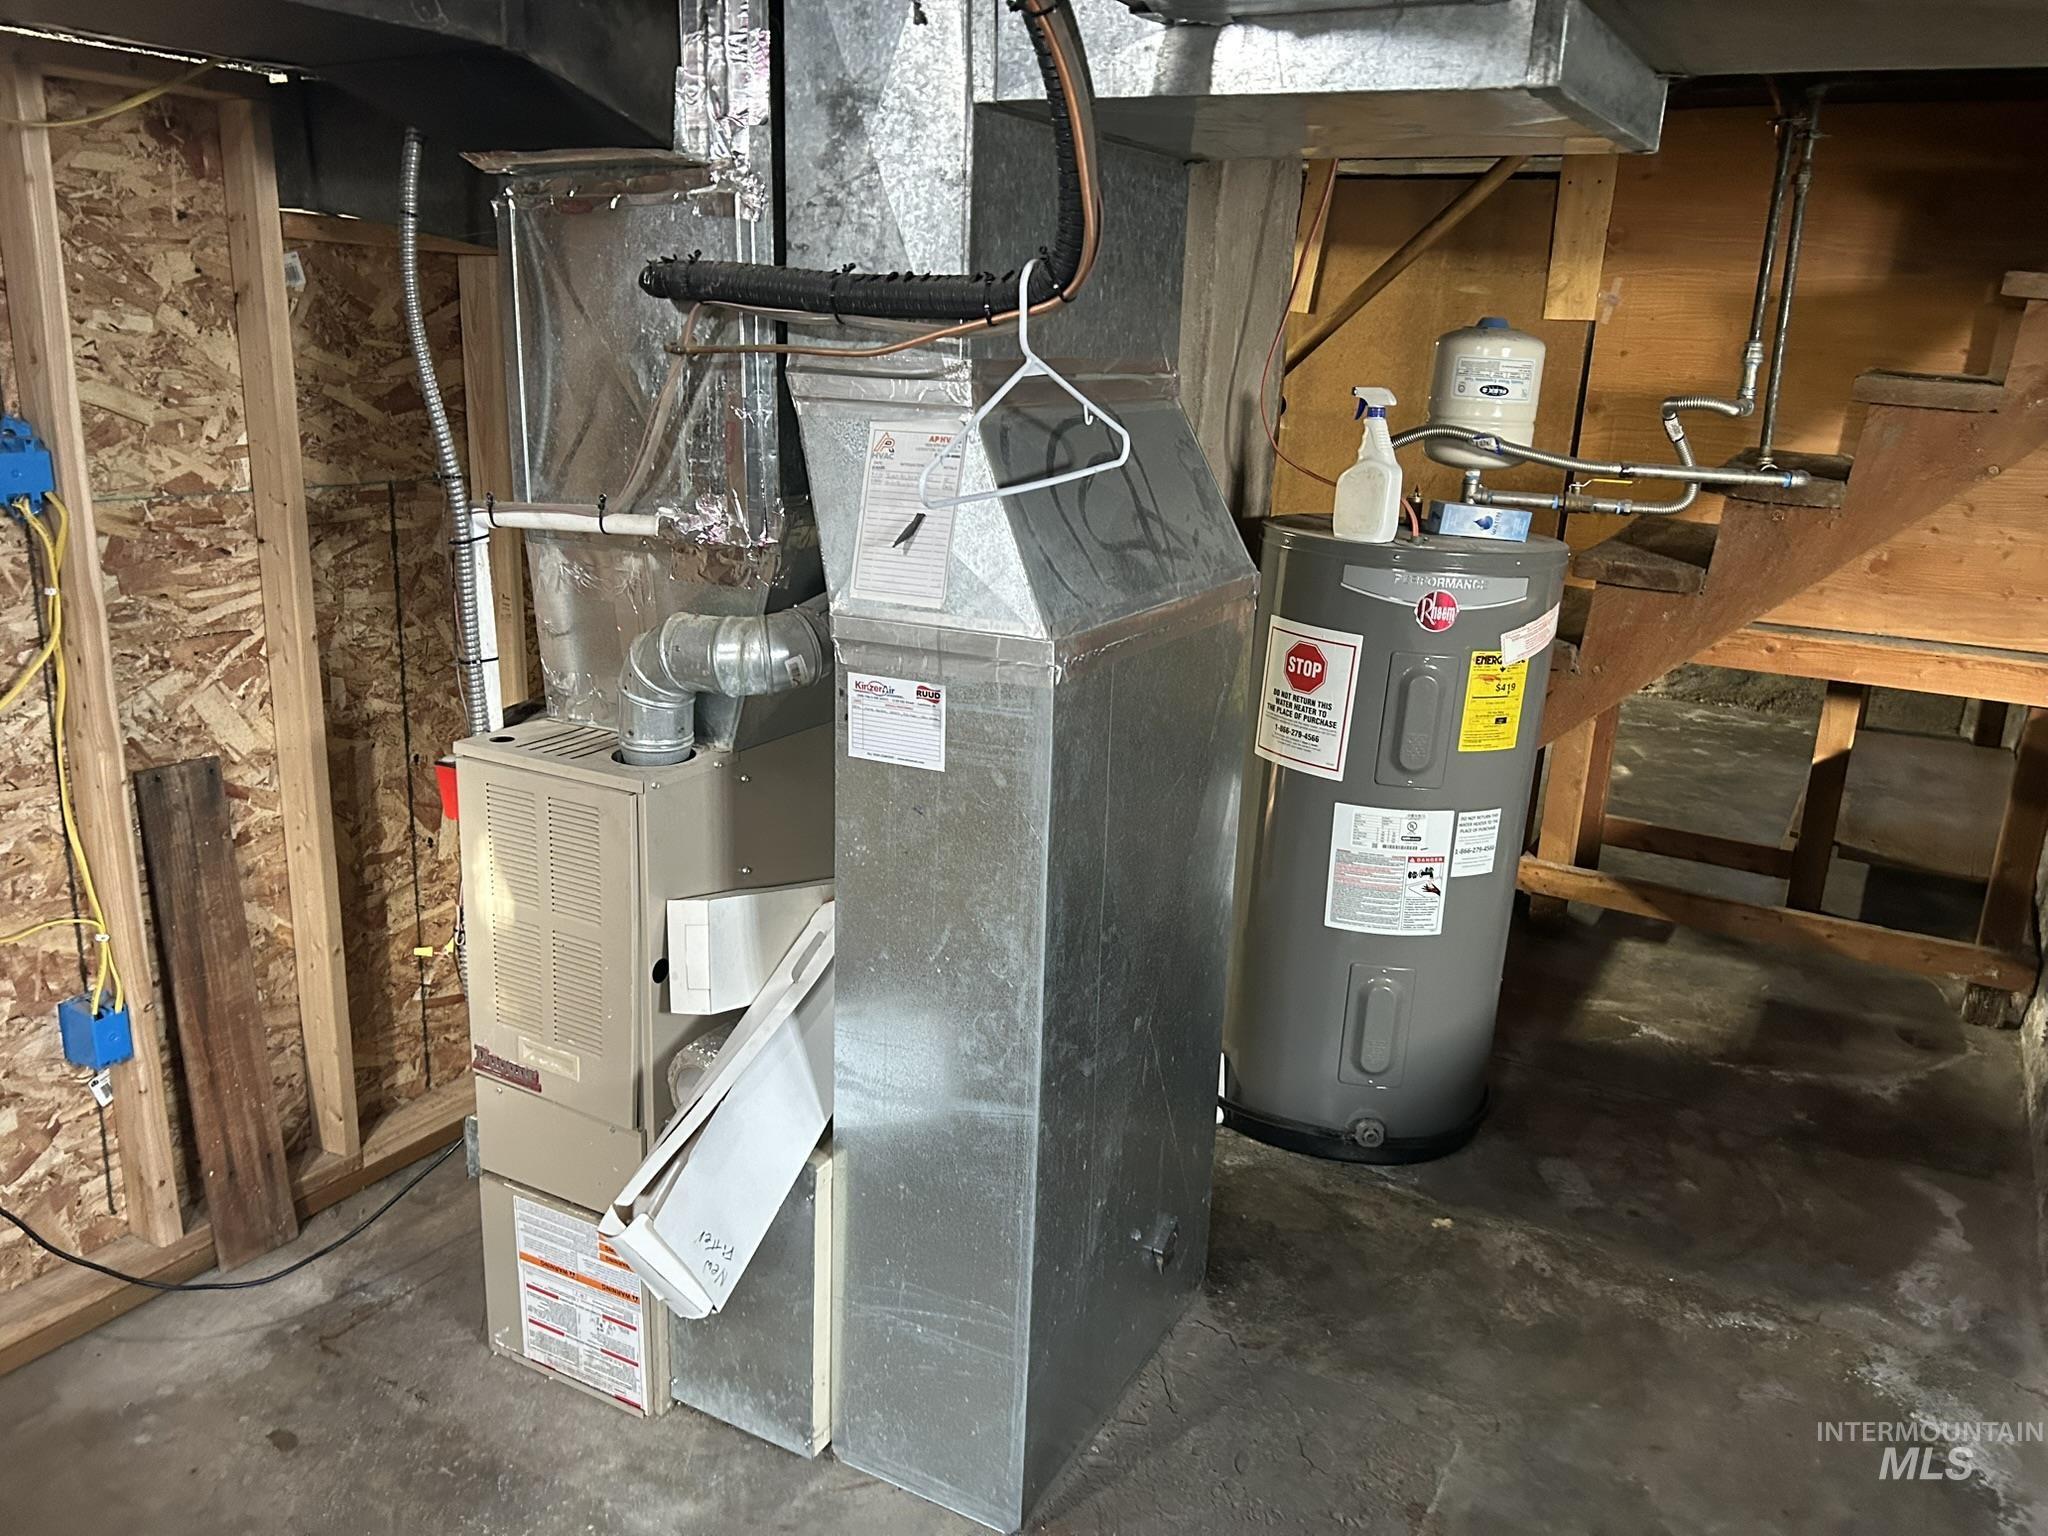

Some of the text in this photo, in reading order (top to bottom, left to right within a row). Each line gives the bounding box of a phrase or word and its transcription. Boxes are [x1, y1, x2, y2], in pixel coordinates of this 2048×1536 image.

[1394, 573, 1488, 590] PERFORMANCE
[1420, 591, 1456, 625] Rheem
[1288, 655, 1322, 678] STOP
[916, 690, 941, 699] RUUD
[1495, 682, 1516, 693] $419
[1273, 687, 1333, 711] DO NOT RETURN THIS
[1275, 698, 1327, 718] WATER HEATER TO
[1267, 702, 1276, 712] THE
[1276, 705, 1293, 718] PLACE
[1294, 712, 1302, 720] OF
[1303, 714, 1337, 729] PURCHASE
[539, 1259, 568, 1277] WARNING
[702, 1260, 728, 1287] New
[601, 1282, 632, 1301] WARNING
